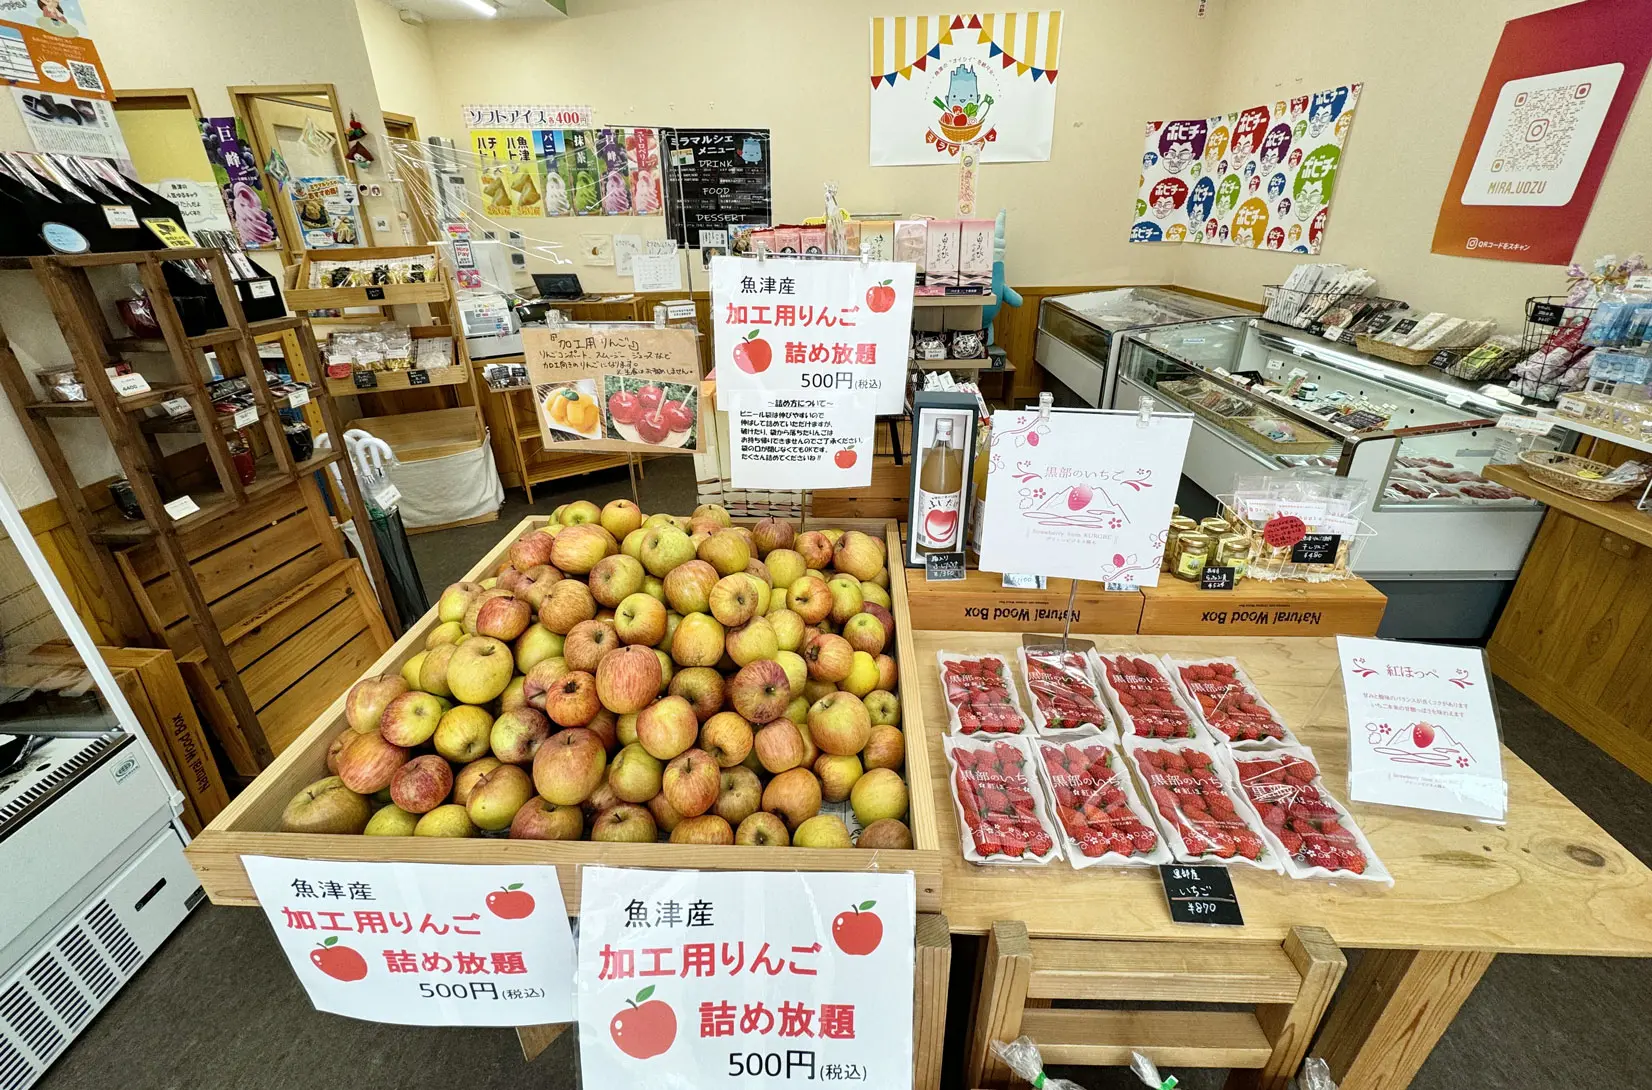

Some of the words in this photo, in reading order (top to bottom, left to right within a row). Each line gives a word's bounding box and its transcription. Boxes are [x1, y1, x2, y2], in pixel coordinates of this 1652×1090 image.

[1316, 88, 1345, 105] ボビチー
[470, 110, 546, 124] ソフトアイス
[1238, 111, 1267, 133] ボビチー
[1167, 123, 1206, 140] ボビチー
[670, 135, 734, 146] ミラマルシェ
[1209, 133, 1228, 145] ボビチー
[1266, 131, 1290, 147] ボビチー
[216, 126, 241, 168] 巨峰
[518, 136, 530, 161] 魚津
[698, 146, 735, 155] メニュー
[698, 160, 733, 168] DRINK
[1155, 183, 1185, 196] ボビチー
[1193, 185, 1213, 201] ボビチー
[1220, 181, 1239, 194] ボビチー
[1487, 181, 1547, 195] MIRA_UOZU
[696, 214, 746, 222] DESSERT
[1236, 207, 1266, 226] ボビチー
[1131, 227, 1159, 238] ボビチー
[1478, 240, 1531, 251] QRコードをスキャン
[740, 276, 796, 295] 魚津産
[726, 302, 860, 328] 加工用りんご
[785, 342, 878, 366] 詰め放題
[740, 411, 824, 419] ビニール袋は伸びやすいので
[741, 420, 833, 428] 伸ばして詰めていただけますが、
[741, 428, 833, 436] 破けたり、袋から落ちたりんごは
[741, 437, 863, 445] お持ち帰りできませんのでご了承ください。
[741, 445, 828, 453] 袋の口が閉じなくてもOKです。
[1044, 466, 1125, 481] 黒部のいちご
[965, 607, 989, 620] Box
[993, 608, 1030, 621] Wood
[1035, 609, 1080, 622] Natural
[1201, 611, 1226, 624] Box
[1231, 611, 1269, 624] Wood
[1273, 612, 1322, 624] Natural
[1386, 664, 1440, 679] 紅ほっぺ
[172, 712, 188, 737] Box
[178, 732, 198, 768] Wood
[192, 758, 211, 794] Natural
[291, 878, 376, 901] 魚津産
[1179, 884, 1212, 897] いちご
[624, 898, 715, 928] 魚津産
[1187, 902, 1217, 915] ¥870
[281, 905, 482, 937] 加工用りんご
[382, 949, 528, 975] 詰め放題
[598, 941, 823, 980] 加工用りんご
[699, 1000, 856, 1040] 詰め放題
